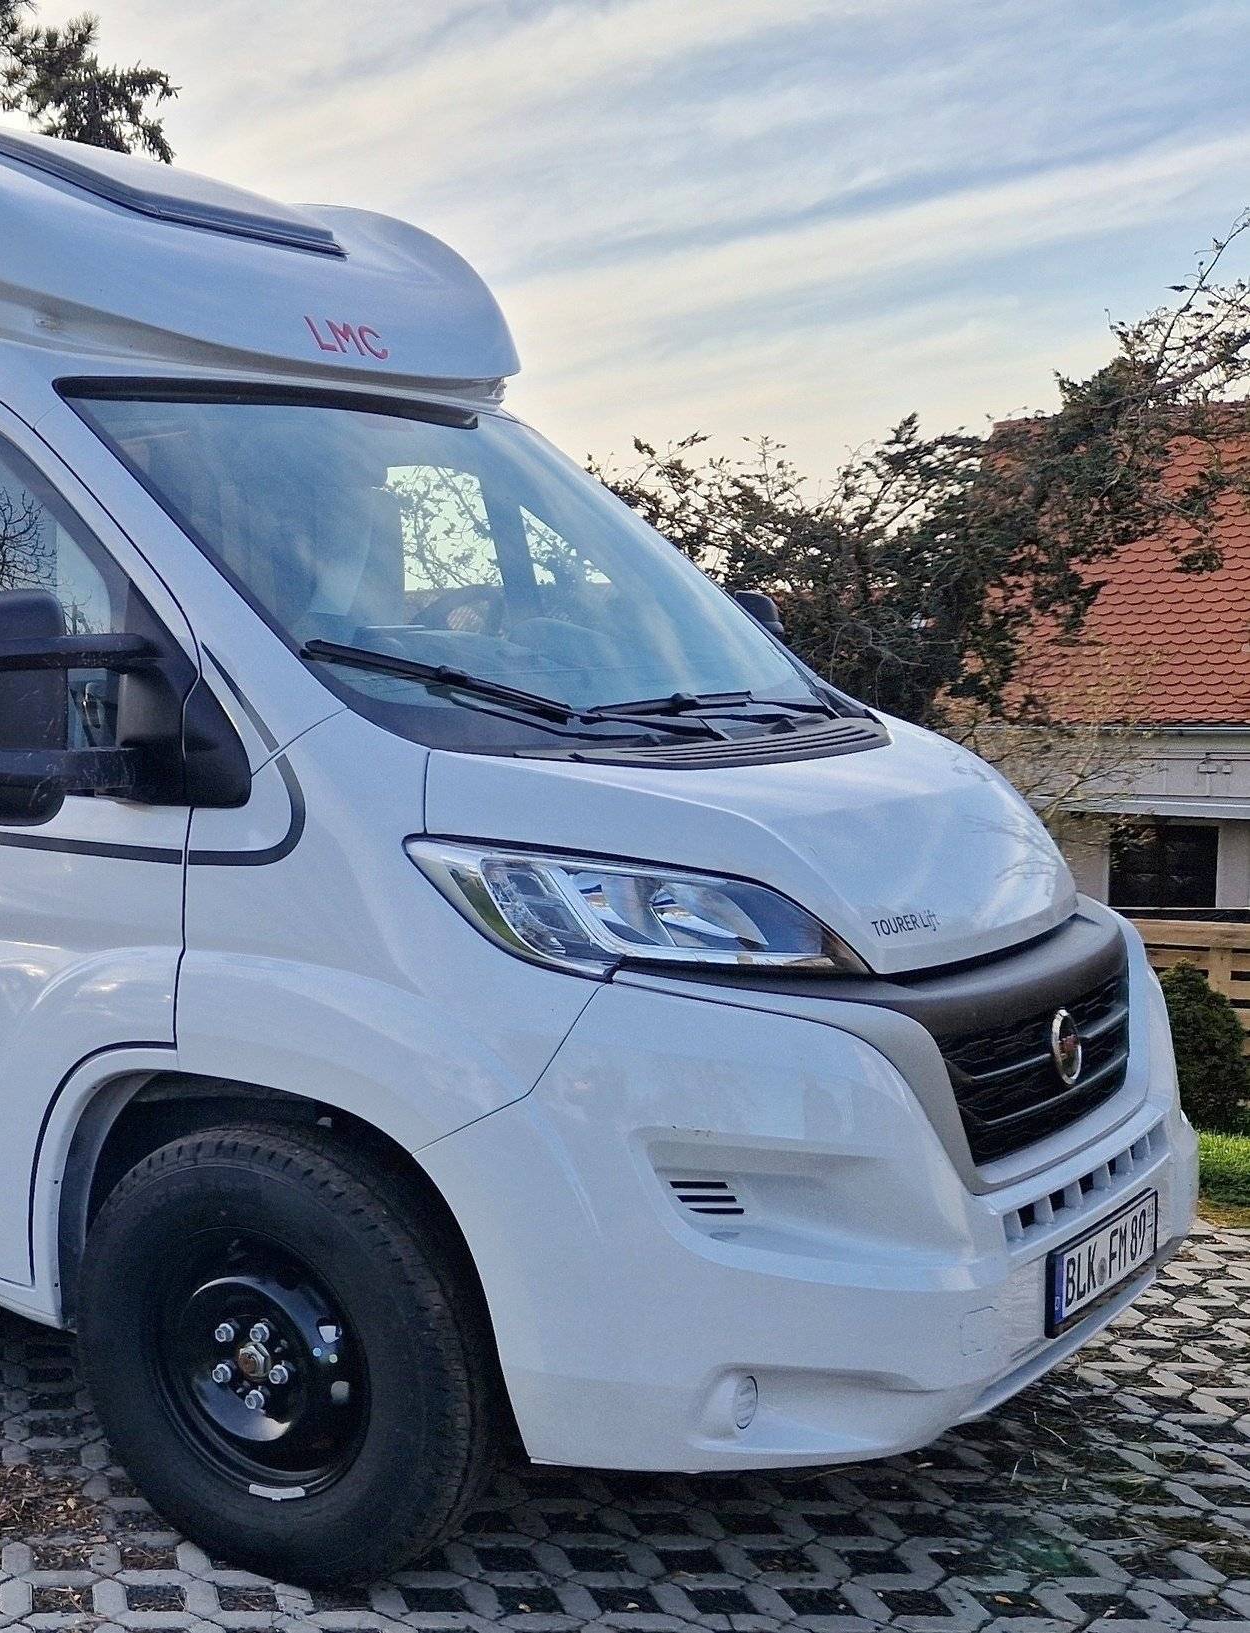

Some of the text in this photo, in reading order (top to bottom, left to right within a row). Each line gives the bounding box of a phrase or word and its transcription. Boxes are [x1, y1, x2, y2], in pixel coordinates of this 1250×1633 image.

[303, 315, 389, 360] LMC
[870, 909, 941, 937] TOURER Lift
[1065, 1209, 1146, 1308] BLK FM 89
